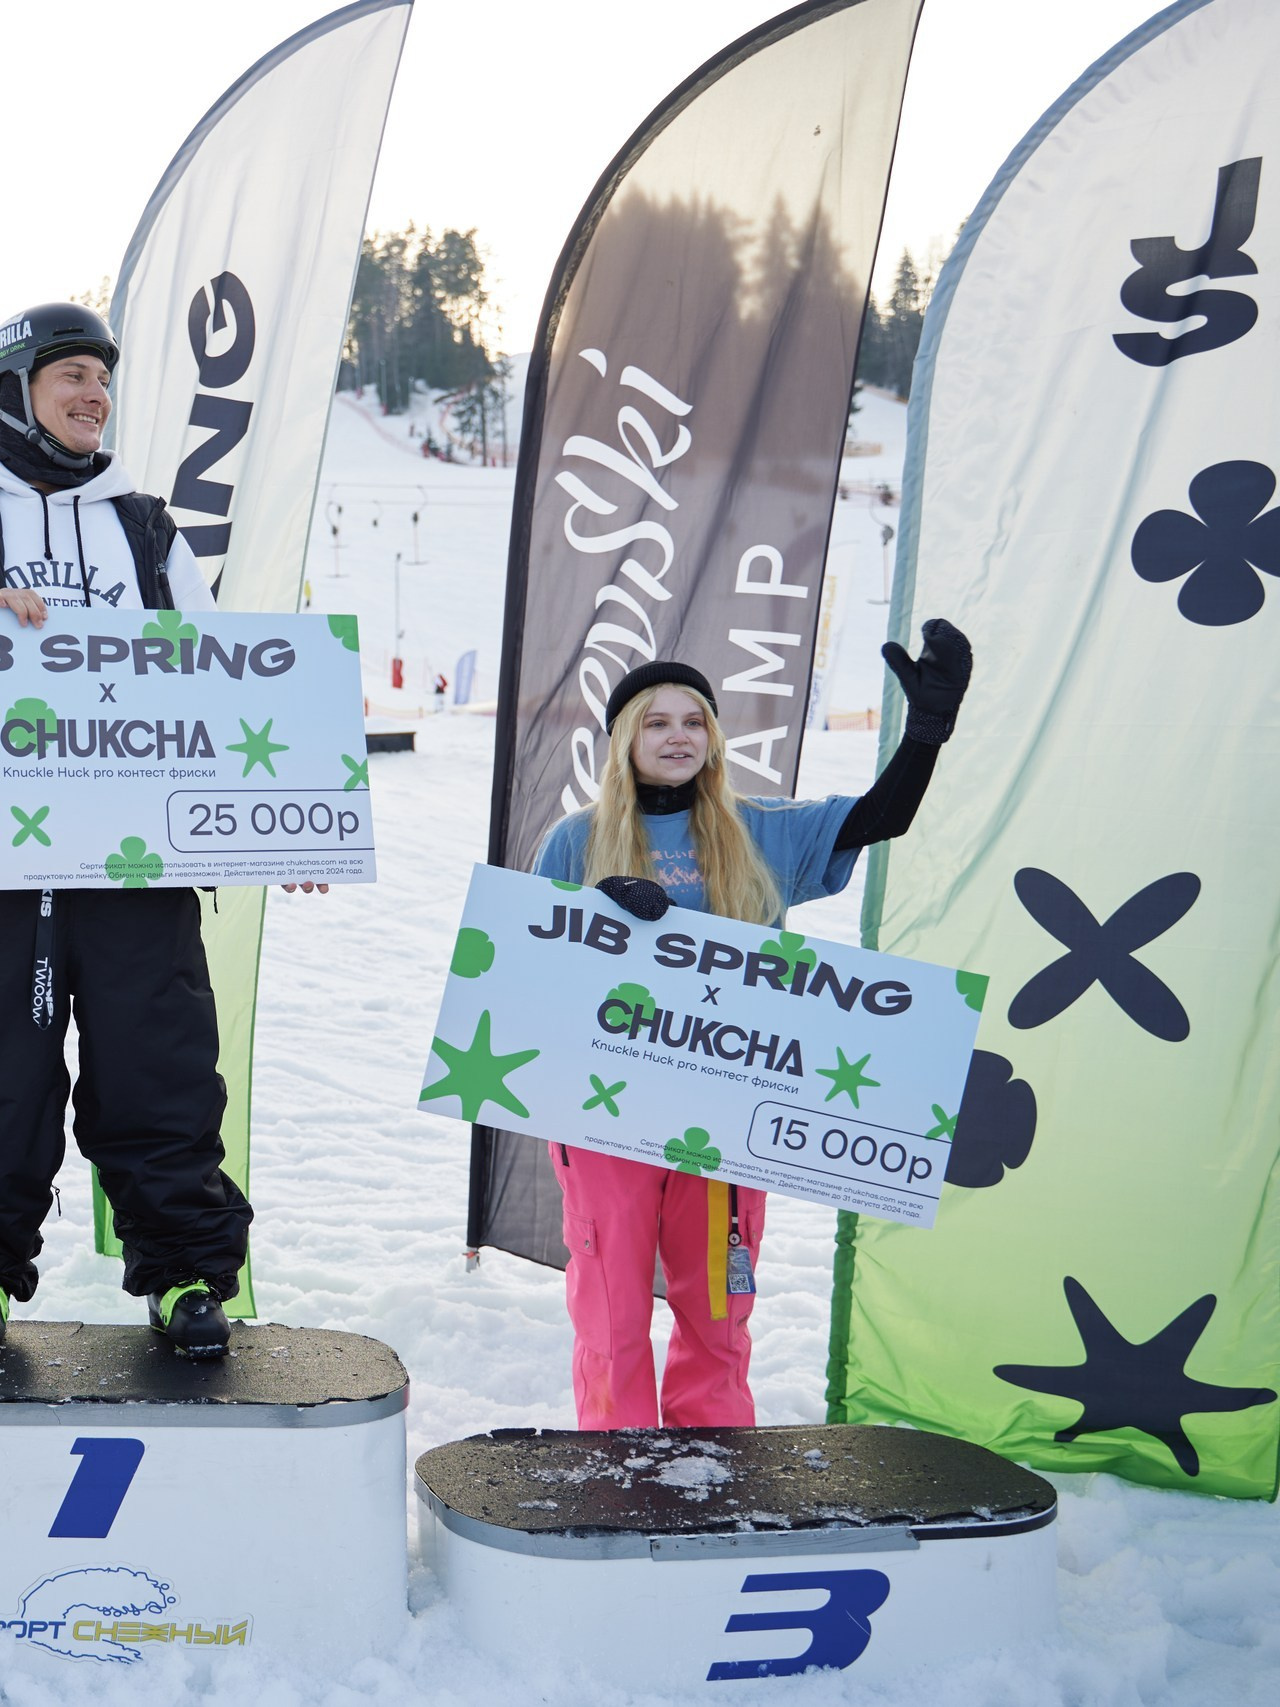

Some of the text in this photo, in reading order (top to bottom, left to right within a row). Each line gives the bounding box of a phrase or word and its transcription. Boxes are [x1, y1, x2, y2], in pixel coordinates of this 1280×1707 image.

[169, 270, 256, 604] ING
[5, 560, 128, 608] ORILLA
[40, 634, 295, 680] SPRING
[721, 543, 810, 786] AMP
[0, 718, 215, 760] CHUKCHA
[3, 767, 216, 780] Knuckle Huck pro контест фриски
[189, 803, 236, 835] 25
[23, 873, 74, 881] продуктовую
[223, 868, 275, 877] Действителен
[325, 867, 344, 875] 2024
[79, 861, 127, 871] Сертификат
[213, 860, 284, 869] интернет-магазине
[286, 858, 336, 866] chukchas.com
[528, 905, 912, 1015] JIB SPRING
[597, 998, 803, 1077] CHUKCHA
[590, 1038, 799, 1097] Knuckle Huck pro контест фриски
[770, 1116, 809, 1150] 15
[583, 1135, 633, 1152] продуктовую
[702, 1162, 728, 1174] деньги
[777, 1178, 831, 1198] Действителен
[830, 1192, 842, 1201] до
[842, 1194, 851, 1202] 31
[851, 1197, 881, 1210] августа
[881, 1203, 902, 1214] 2024
[639, 1138, 686, 1156] Сертификат
[685, 1150, 712, 1161] можно
[712, 1156, 763, 1173] использовать
[769, 1169, 842, 1193] интернет-магазине
[843, 1185, 896, 1204] chukchas.com
[897, 1199, 908, 1207] на
[908, 1202, 924, 1211] всю
[47, 1437, 146, 1540] 1
[72, 1619, 250, 1646] СНЕЖНЫЙ
[705, 1568, 892, 1682] 3
